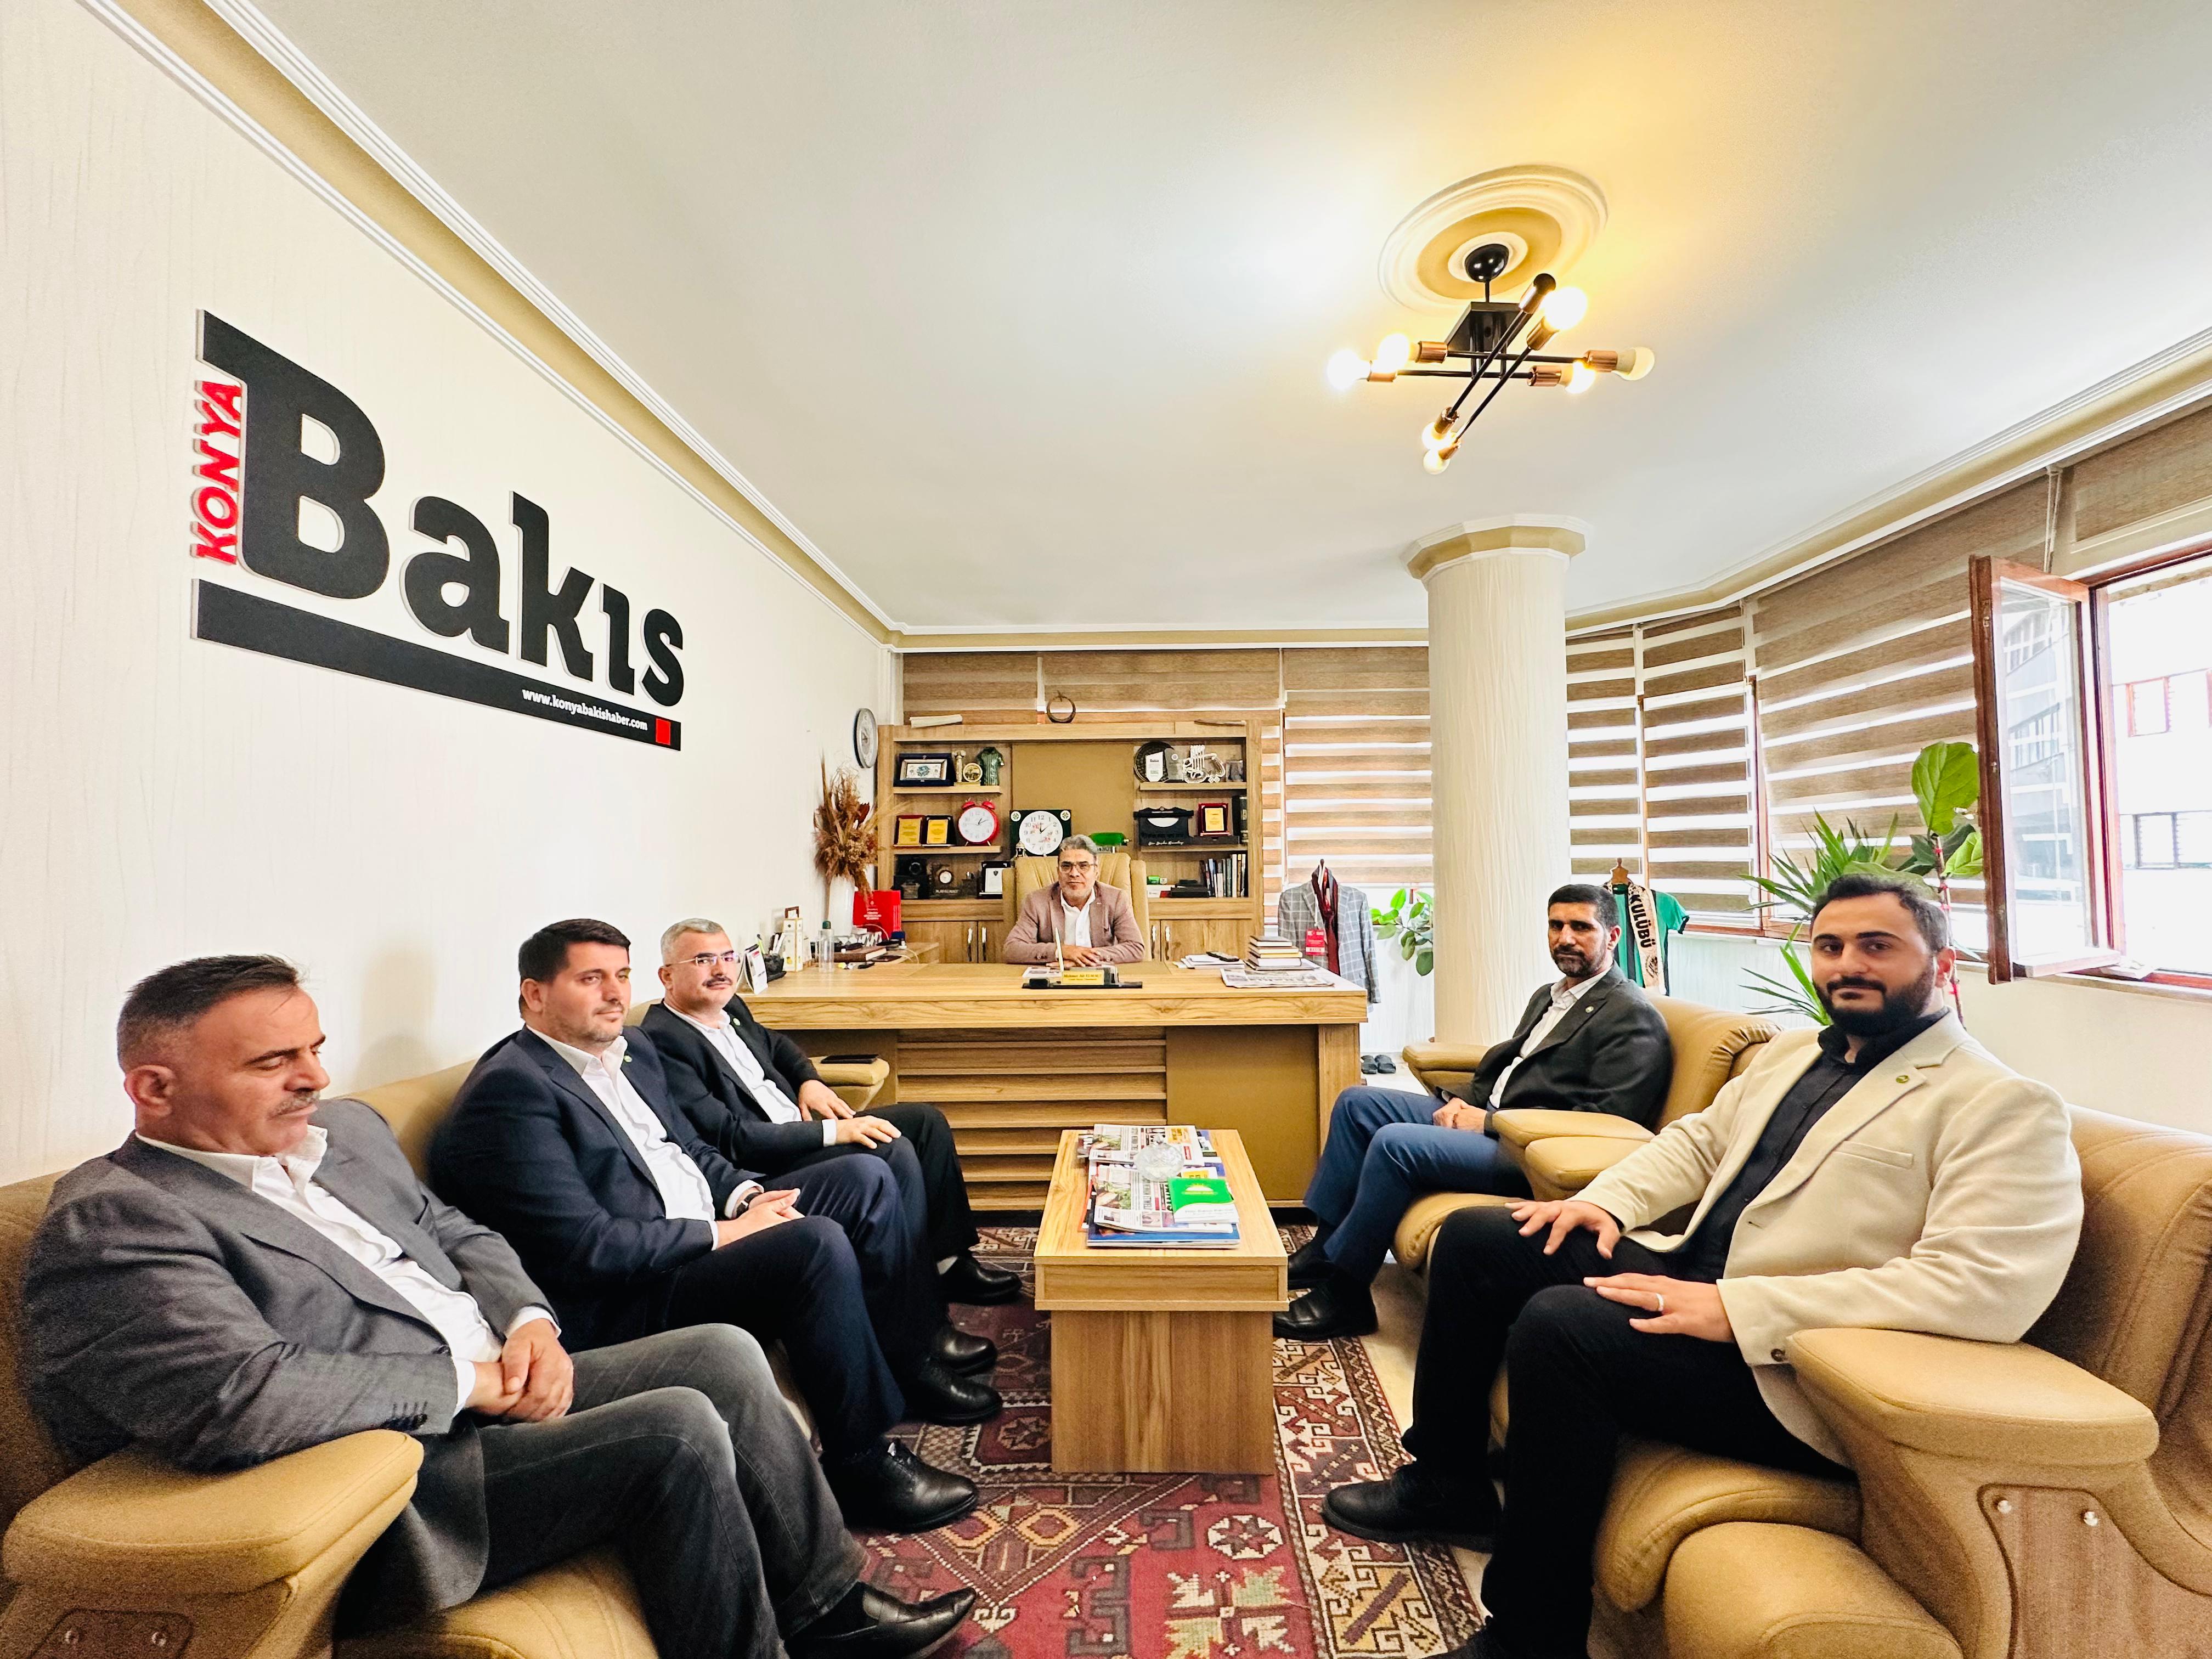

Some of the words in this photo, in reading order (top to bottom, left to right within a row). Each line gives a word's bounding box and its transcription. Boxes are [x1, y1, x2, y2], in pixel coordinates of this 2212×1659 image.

[195, 380, 242, 565] KONYA
[522, 689, 648, 731] www.konyabakishaber.com
[1629, 894, 1656, 948] KULÜBÜ
